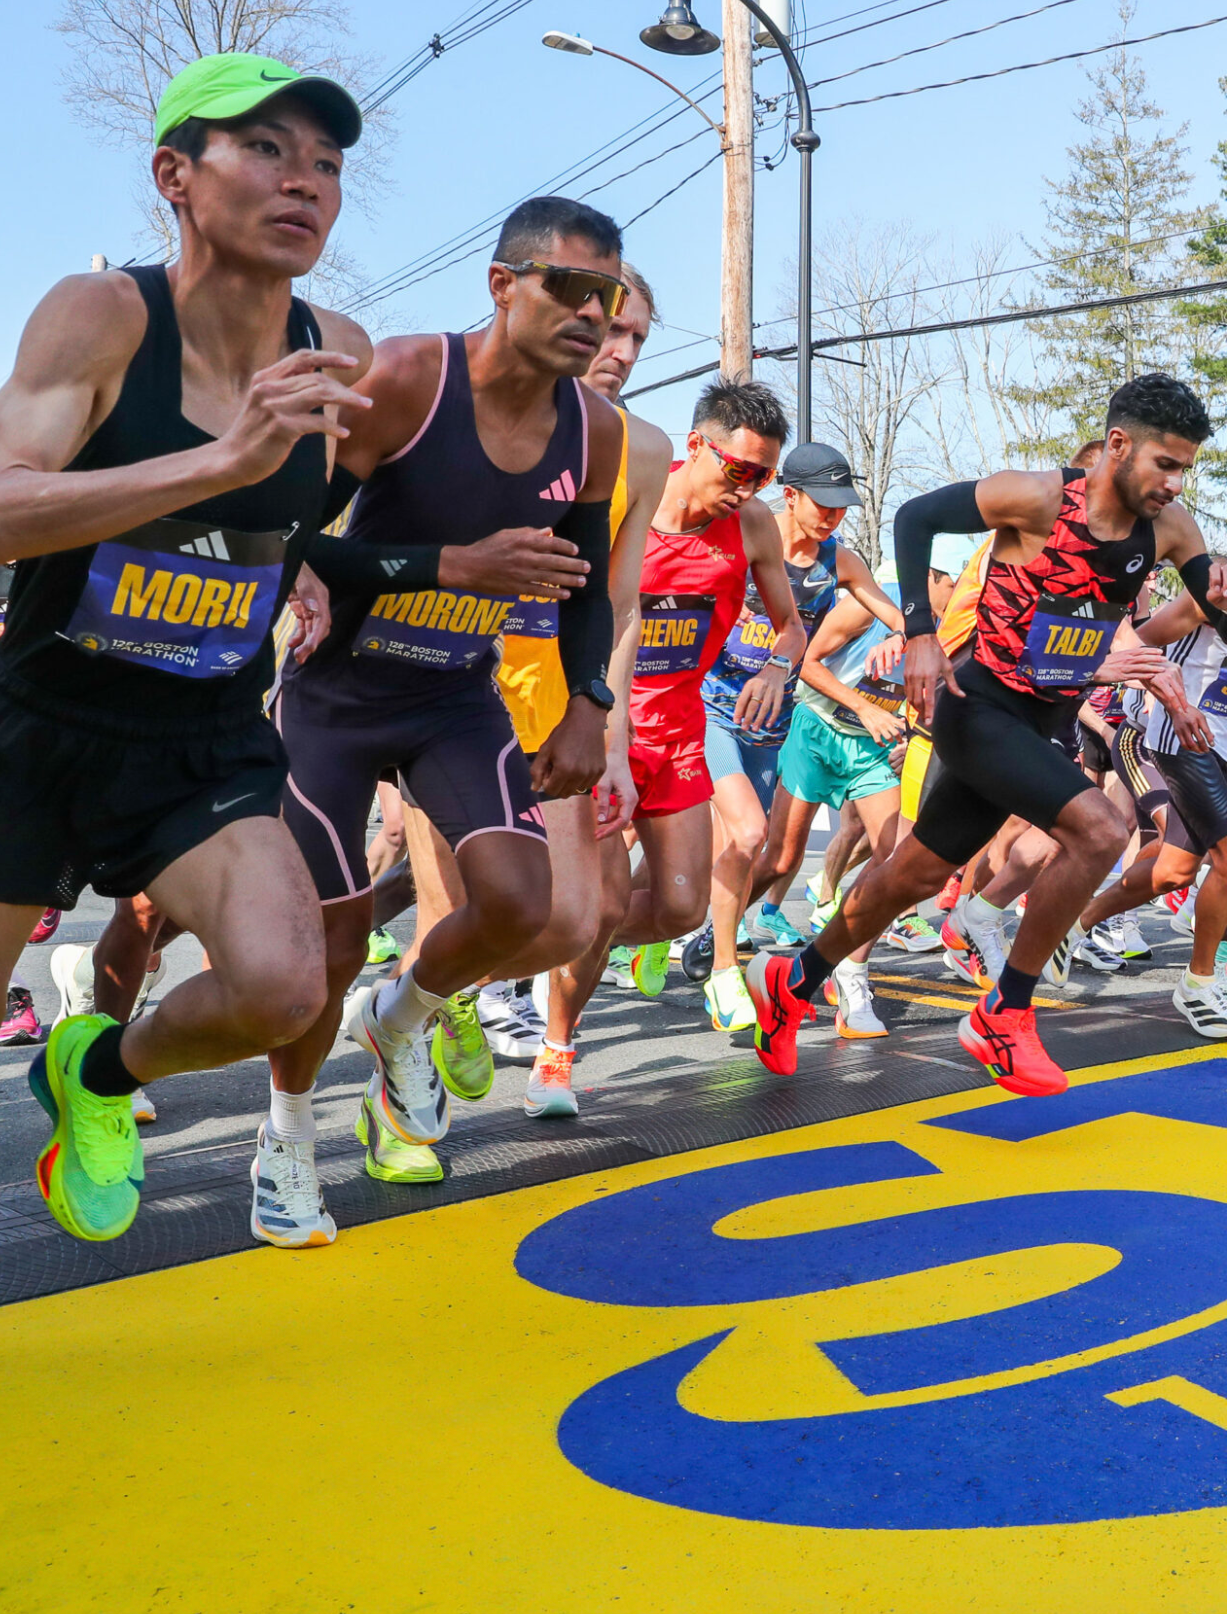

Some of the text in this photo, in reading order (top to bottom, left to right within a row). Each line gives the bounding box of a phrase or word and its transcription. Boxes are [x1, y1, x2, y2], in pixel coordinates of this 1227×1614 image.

[110, 562, 259, 630] MORII
[410, 645, 451, 658] BOSTON
[1043, 624, 1105, 657] TALBI
